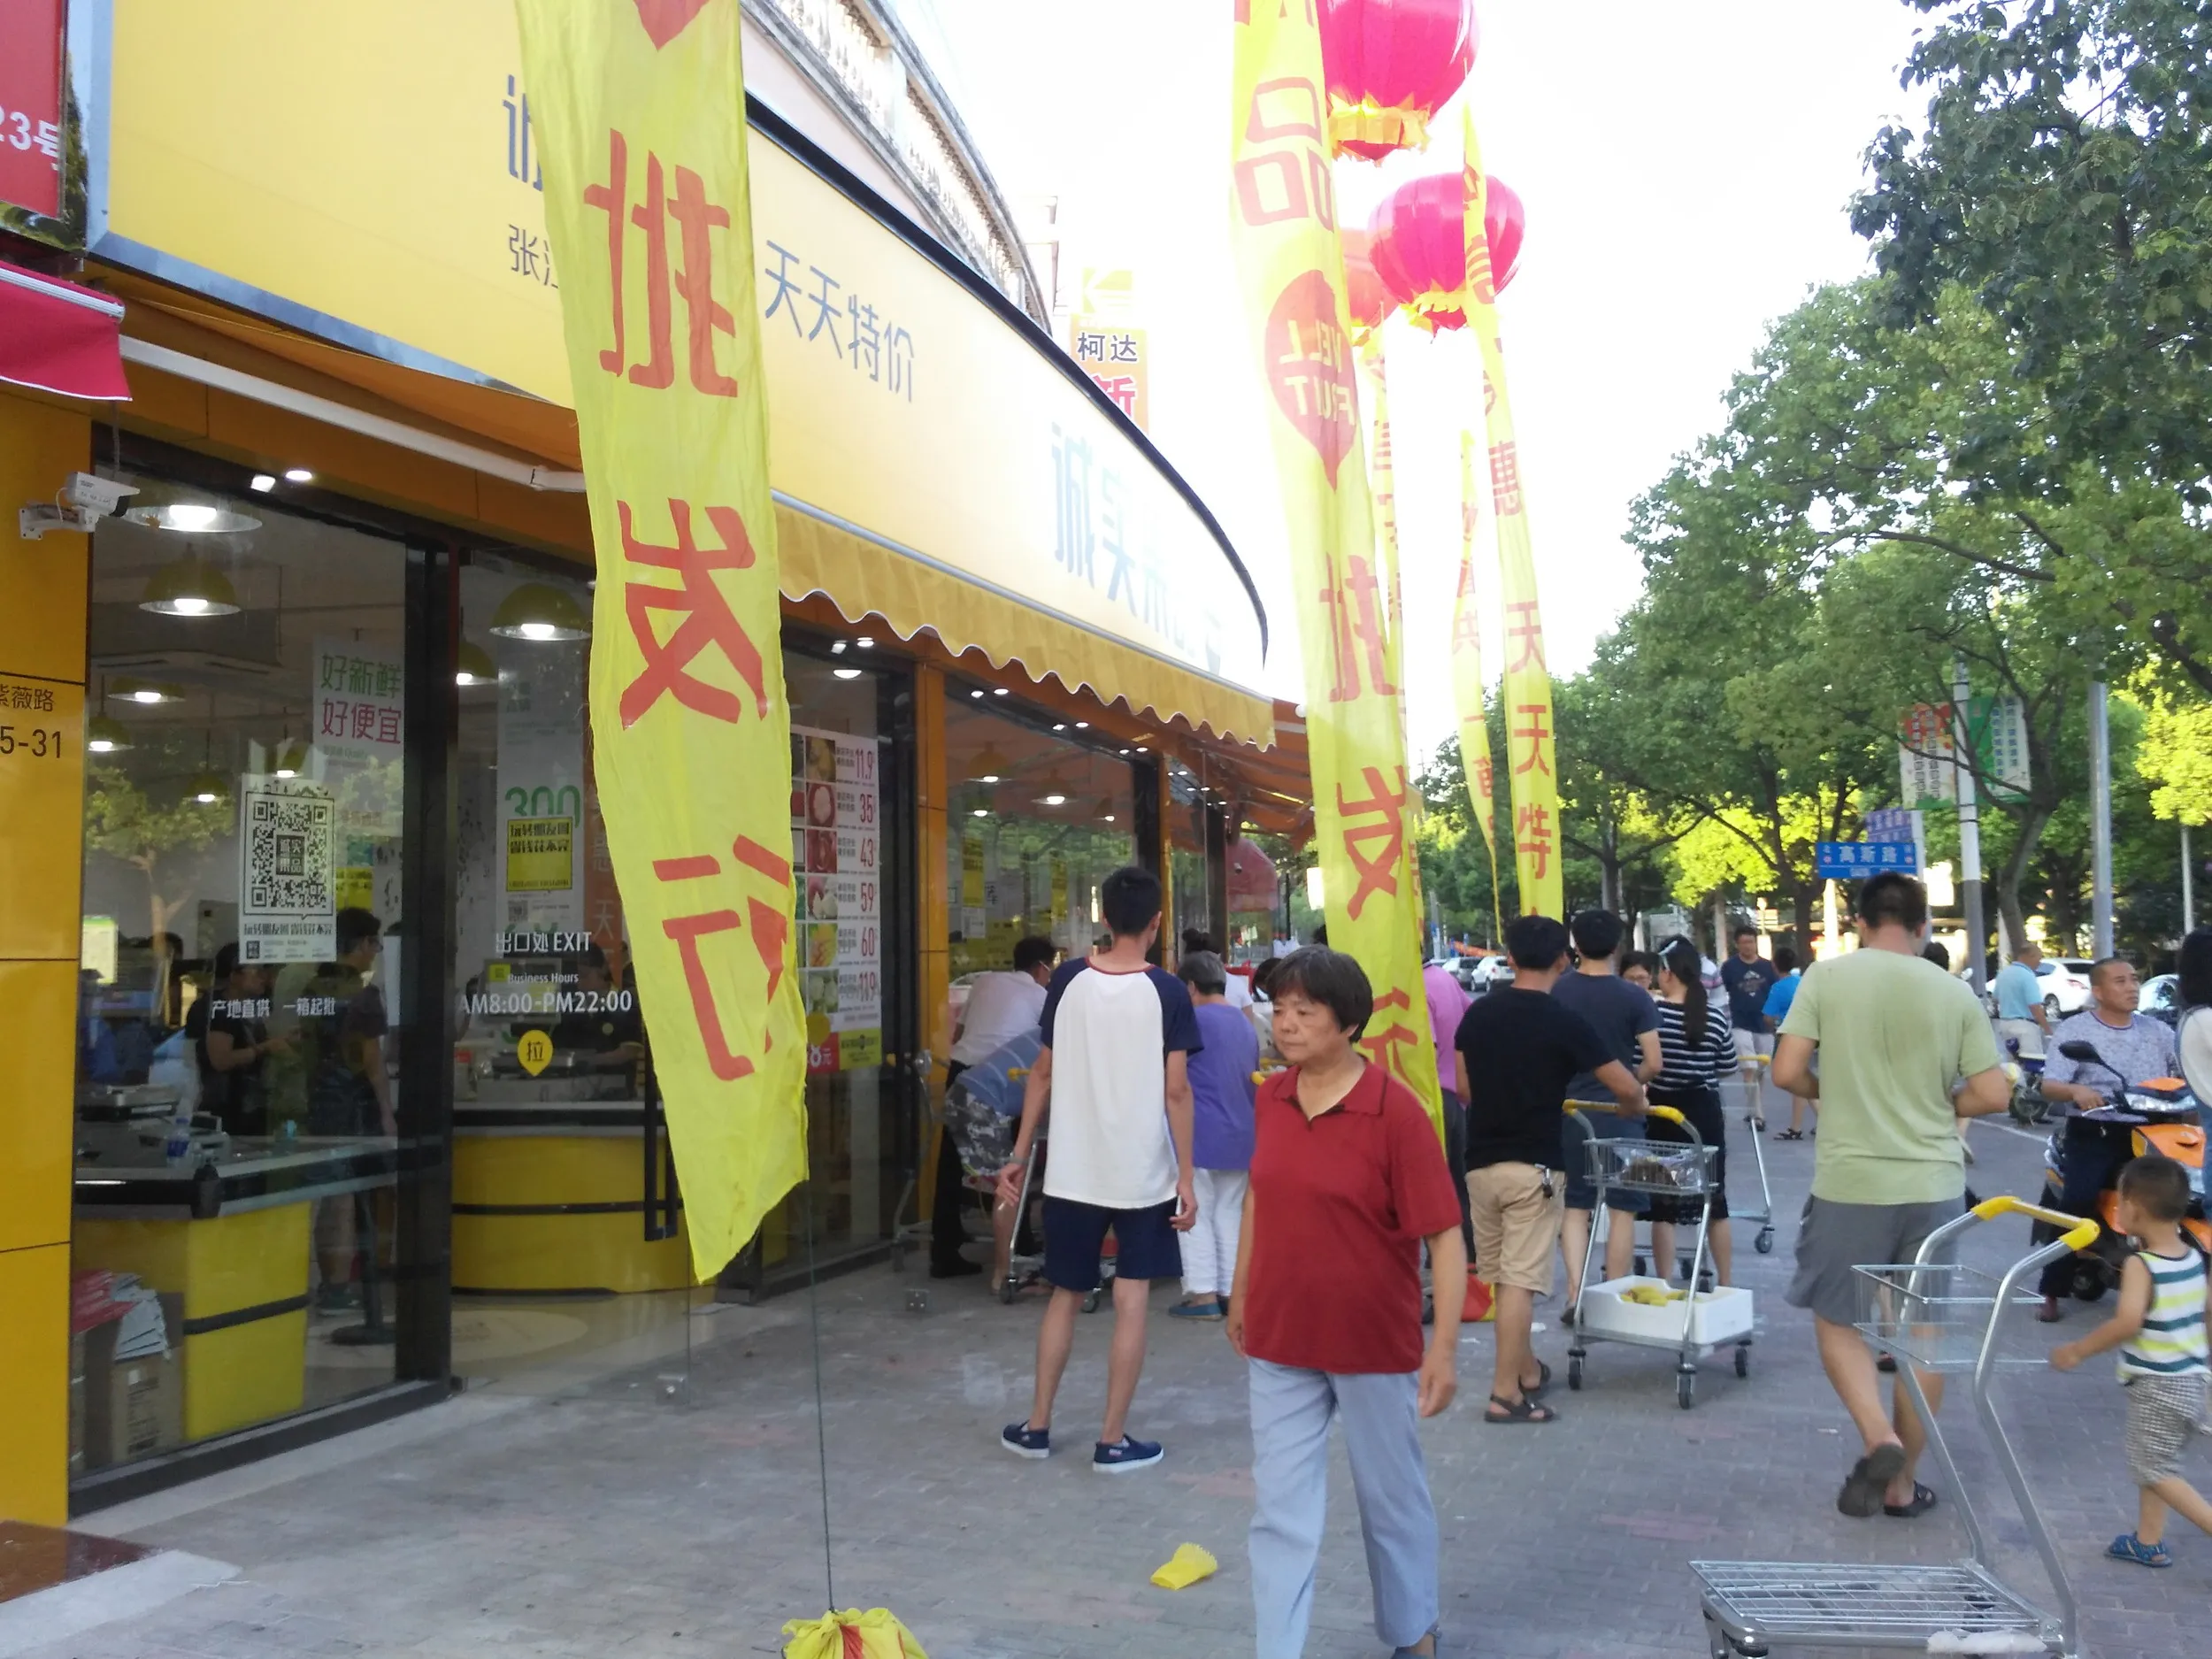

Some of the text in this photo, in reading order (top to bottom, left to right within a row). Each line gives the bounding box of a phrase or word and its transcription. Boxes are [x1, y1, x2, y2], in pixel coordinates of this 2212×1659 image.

[0, 104, 59, 171] 3号
[764, 239, 916, 403] 天天特价
[1077, 332, 1138, 362] 柯达
[321, 654, 402, 699] 好新鲜
[321, 698, 402, 744] 好便宜
[859, 794, 873, 823] 35
[860, 838, 873, 867] 43
[861, 882, 874, 912] 59
[495, 932, 592, 953] 出口处 EXIT
[508, 972, 579, 984] Business Hours
[459, 990, 633, 1014] AM8:00-PM22:00
[526, 1041, 544, 1062] 拉
